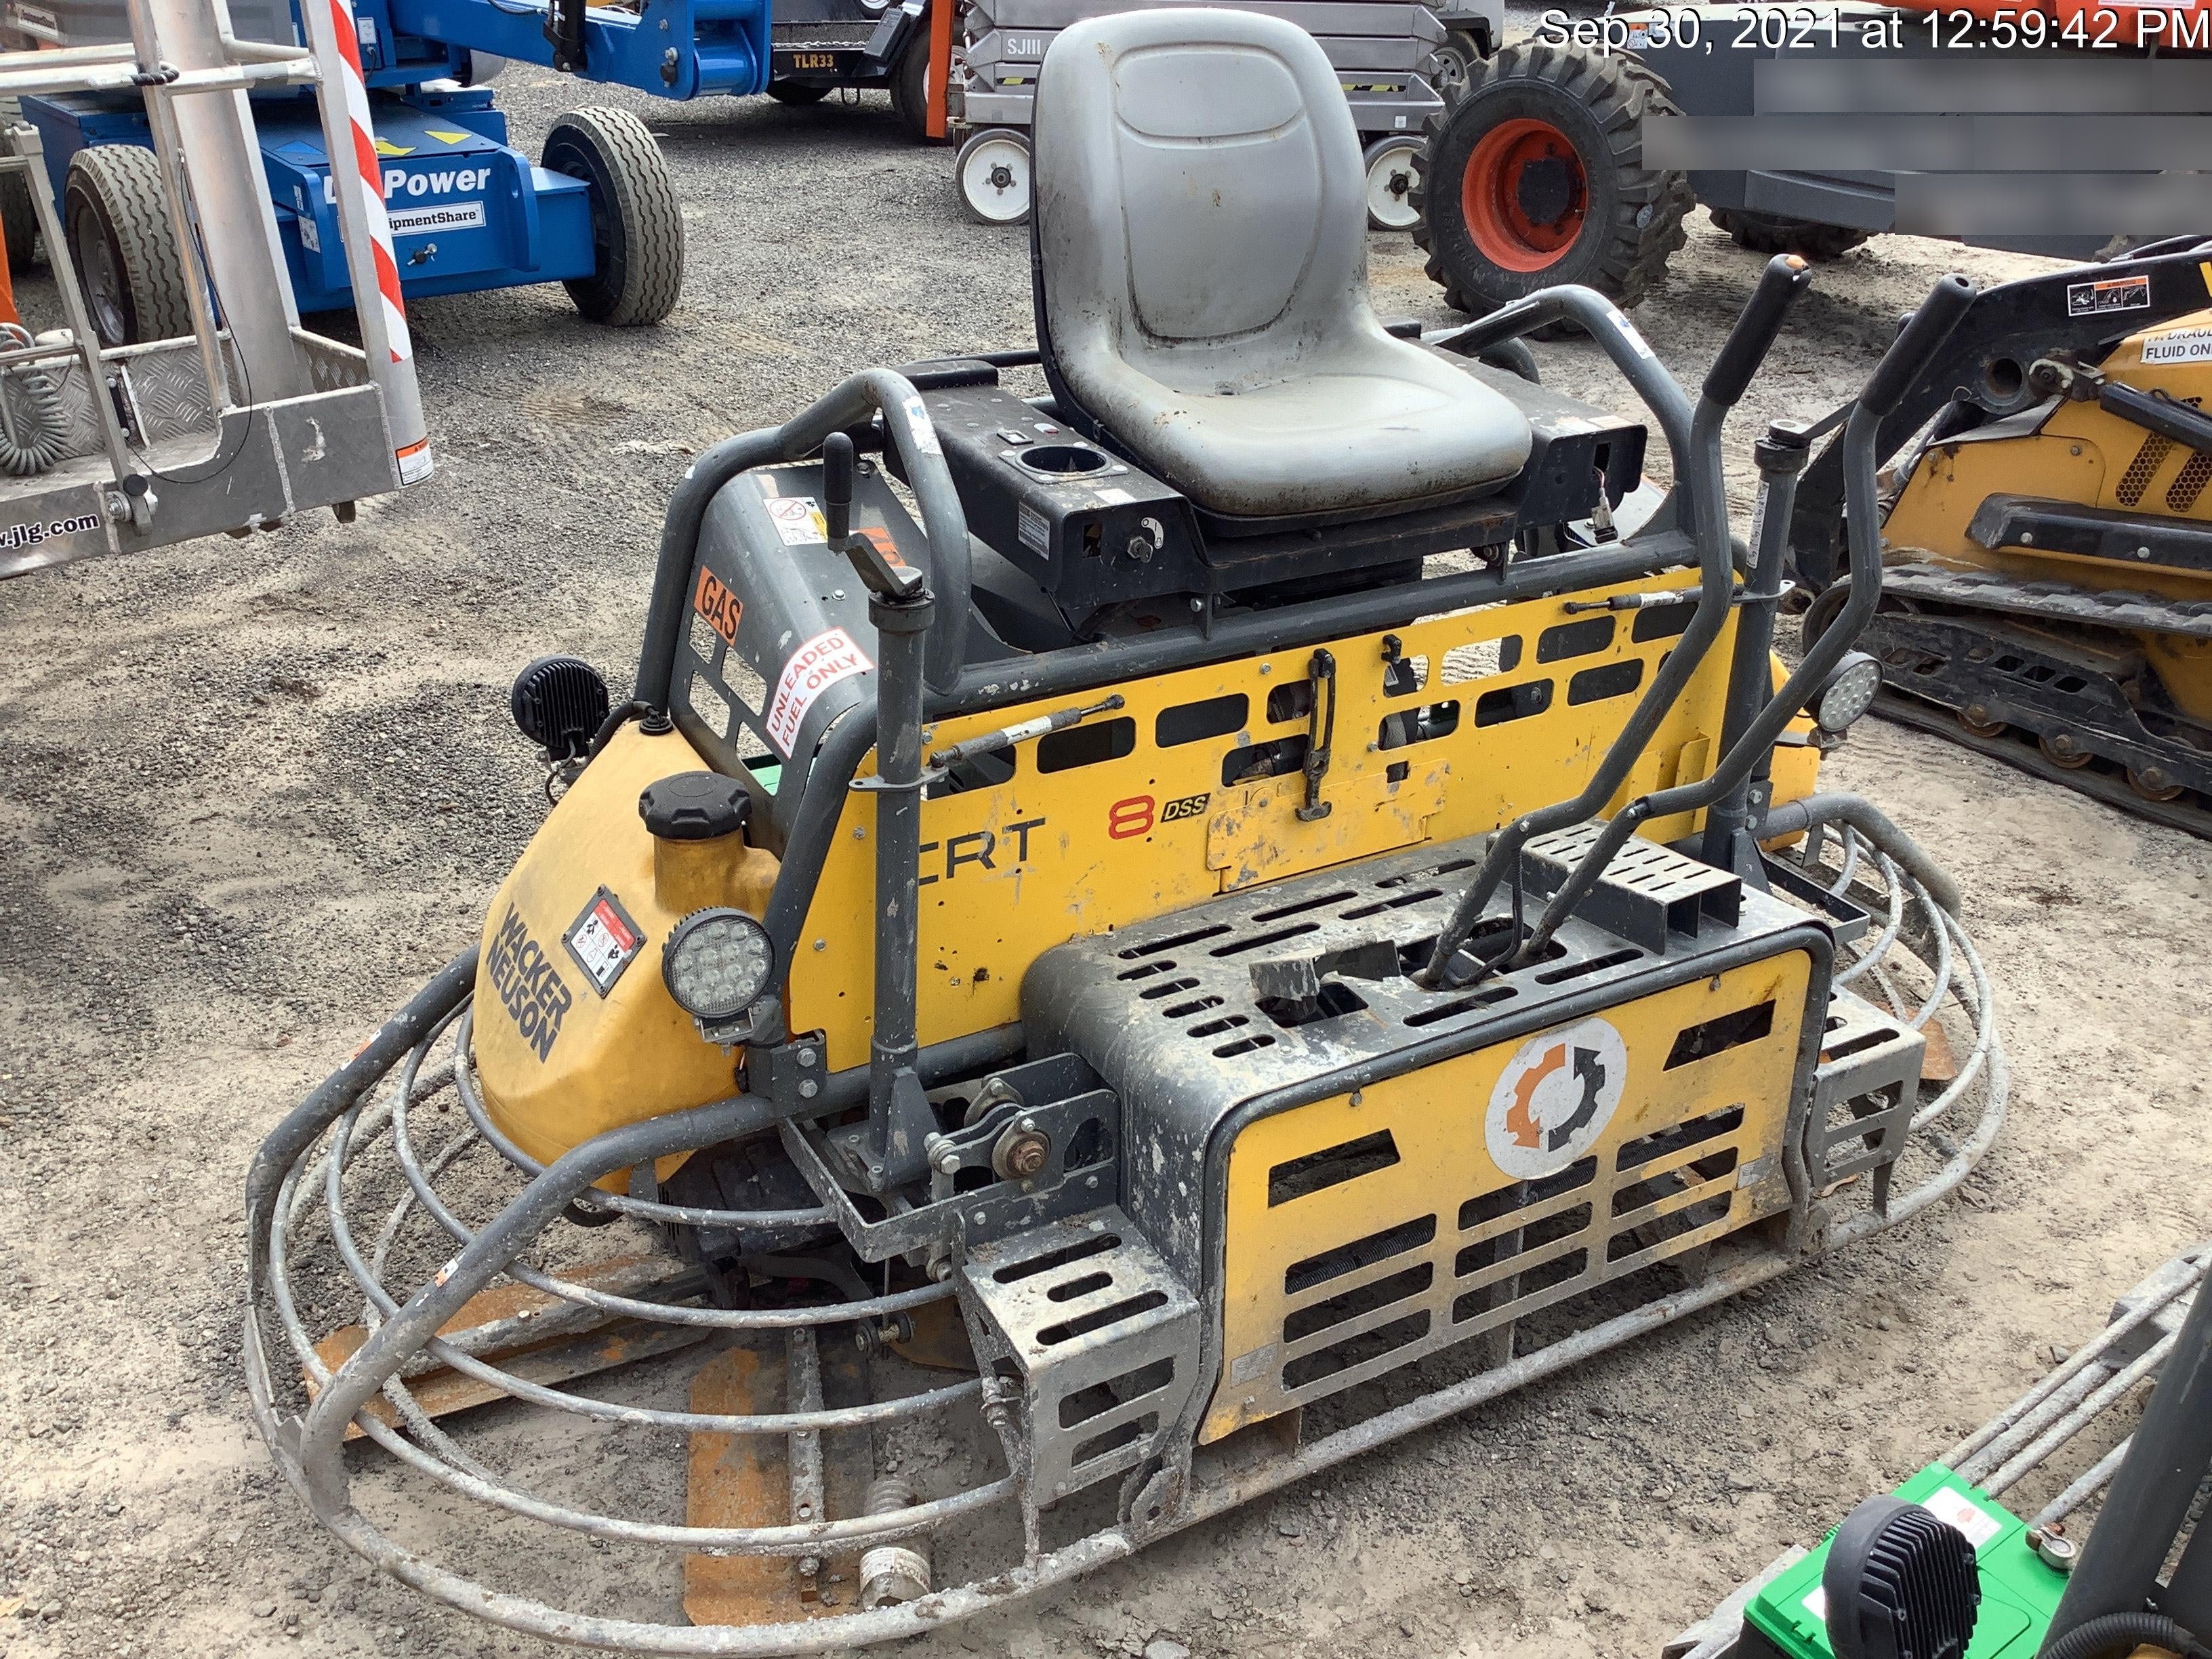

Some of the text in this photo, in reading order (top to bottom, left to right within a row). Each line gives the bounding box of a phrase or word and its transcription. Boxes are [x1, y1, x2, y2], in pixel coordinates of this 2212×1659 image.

[793, 54, 834, 68] TLR33
[1007, 38, 1041, 55] SJIII
[384, 168, 491, 199] Power
[388, 210, 476, 230] ipmentShare
[2146, 343, 2212, 359] FLUID ON
[702, 575, 740, 639] GAS
[771, 637, 844, 732] UNLEADED
[781, 653, 858, 747] FUEL ONLY
[1108, 792, 1210, 840] 8 DSS
[500, 901, 572, 1031] WACKER
[486, 933, 558, 1064] NEUSON
